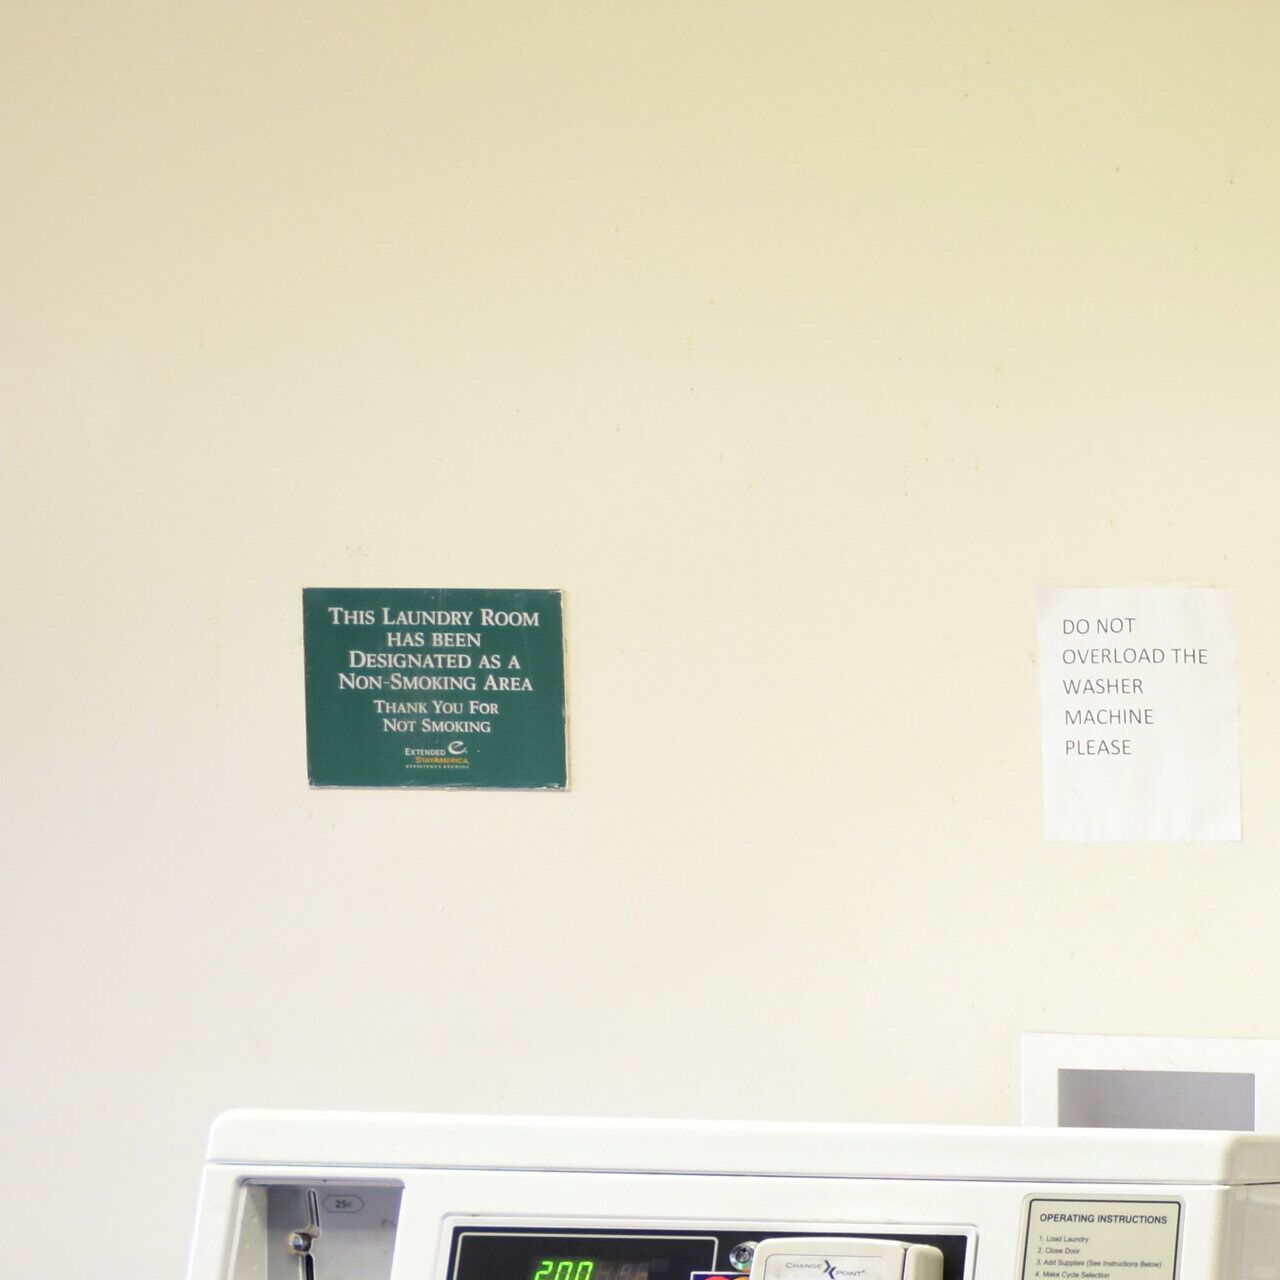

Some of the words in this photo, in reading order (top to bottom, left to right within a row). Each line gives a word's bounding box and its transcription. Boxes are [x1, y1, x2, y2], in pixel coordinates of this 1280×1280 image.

[328, 607, 375, 624] THIS
[383, 608, 473, 626] LAUNDRY
[480, 609, 540, 626] ROOM
[1062, 618, 1090, 636] DO
[1097, 617, 1136, 635] NOT
[386, 632, 424, 647] HAS
[432, 632, 481, 647] BEEN
[348, 650, 471, 669] DESIGNATED
[479, 655, 500, 669] AS
[508, 656, 521, 669] A
[1062, 647, 1165, 665] OVERLOAD
[1171, 647, 1208, 665] THE
[338, 673, 476, 691] NON-SMOKING
[484, 676, 533, 691] AREA
[1063, 678, 1144, 696] WASHER
[374, 700, 427, 714] THANK
[432, 700, 463, 714] YOU
[469, 701, 499, 714] FOR
[384, 719, 416, 732] NOT
[422, 719, 491, 732] SMOKING
[1065, 708, 1154, 726] MACHINE
[1065, 738, 1132, 756] PLEASE
[1040, 1213, 1095, 1223] OPERATING
[1098, 1214, 1167, 1224] INSTRUCTIONS
[1063, 1236, 1089, 1244] Laundry
